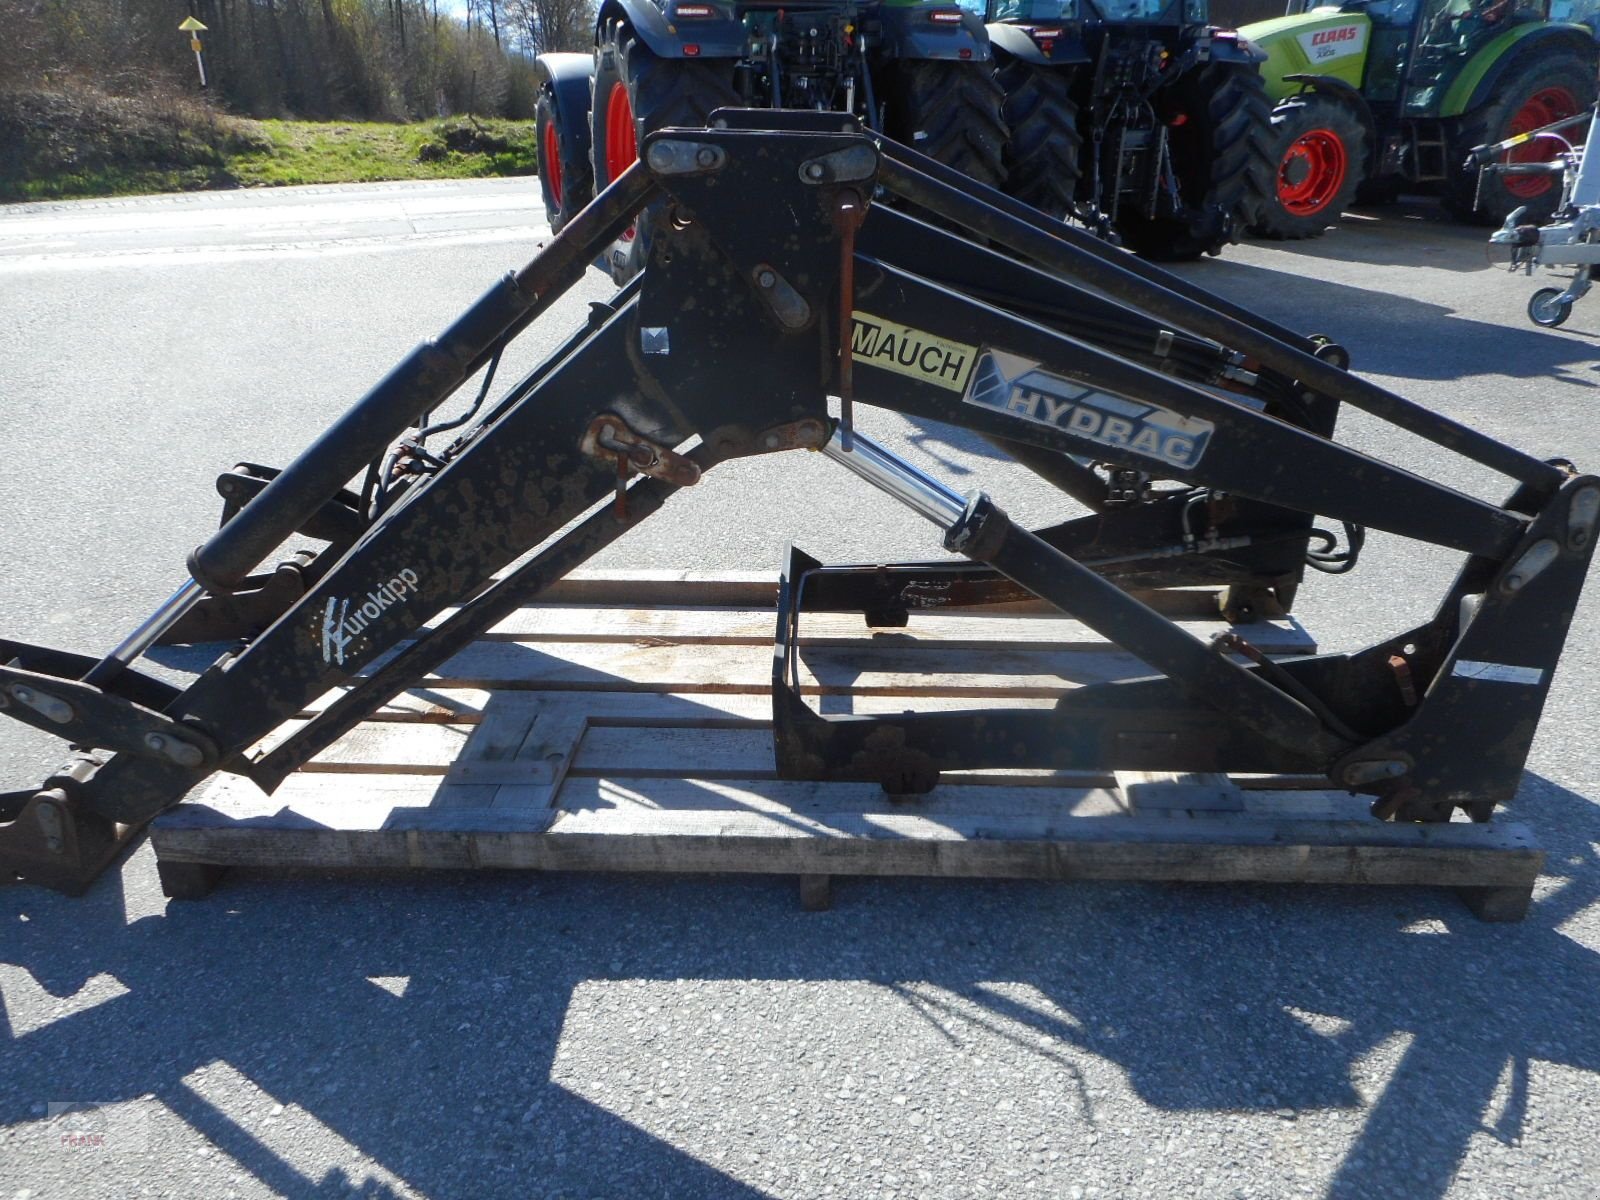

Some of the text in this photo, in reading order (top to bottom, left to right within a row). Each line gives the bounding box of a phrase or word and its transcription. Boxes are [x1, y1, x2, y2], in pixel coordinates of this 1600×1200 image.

[1312, 28, 1356, 45] CLAAS
[852, 323, 965, 381] MAUCH
[1007, 386, 1195, 463] HYDRAC
